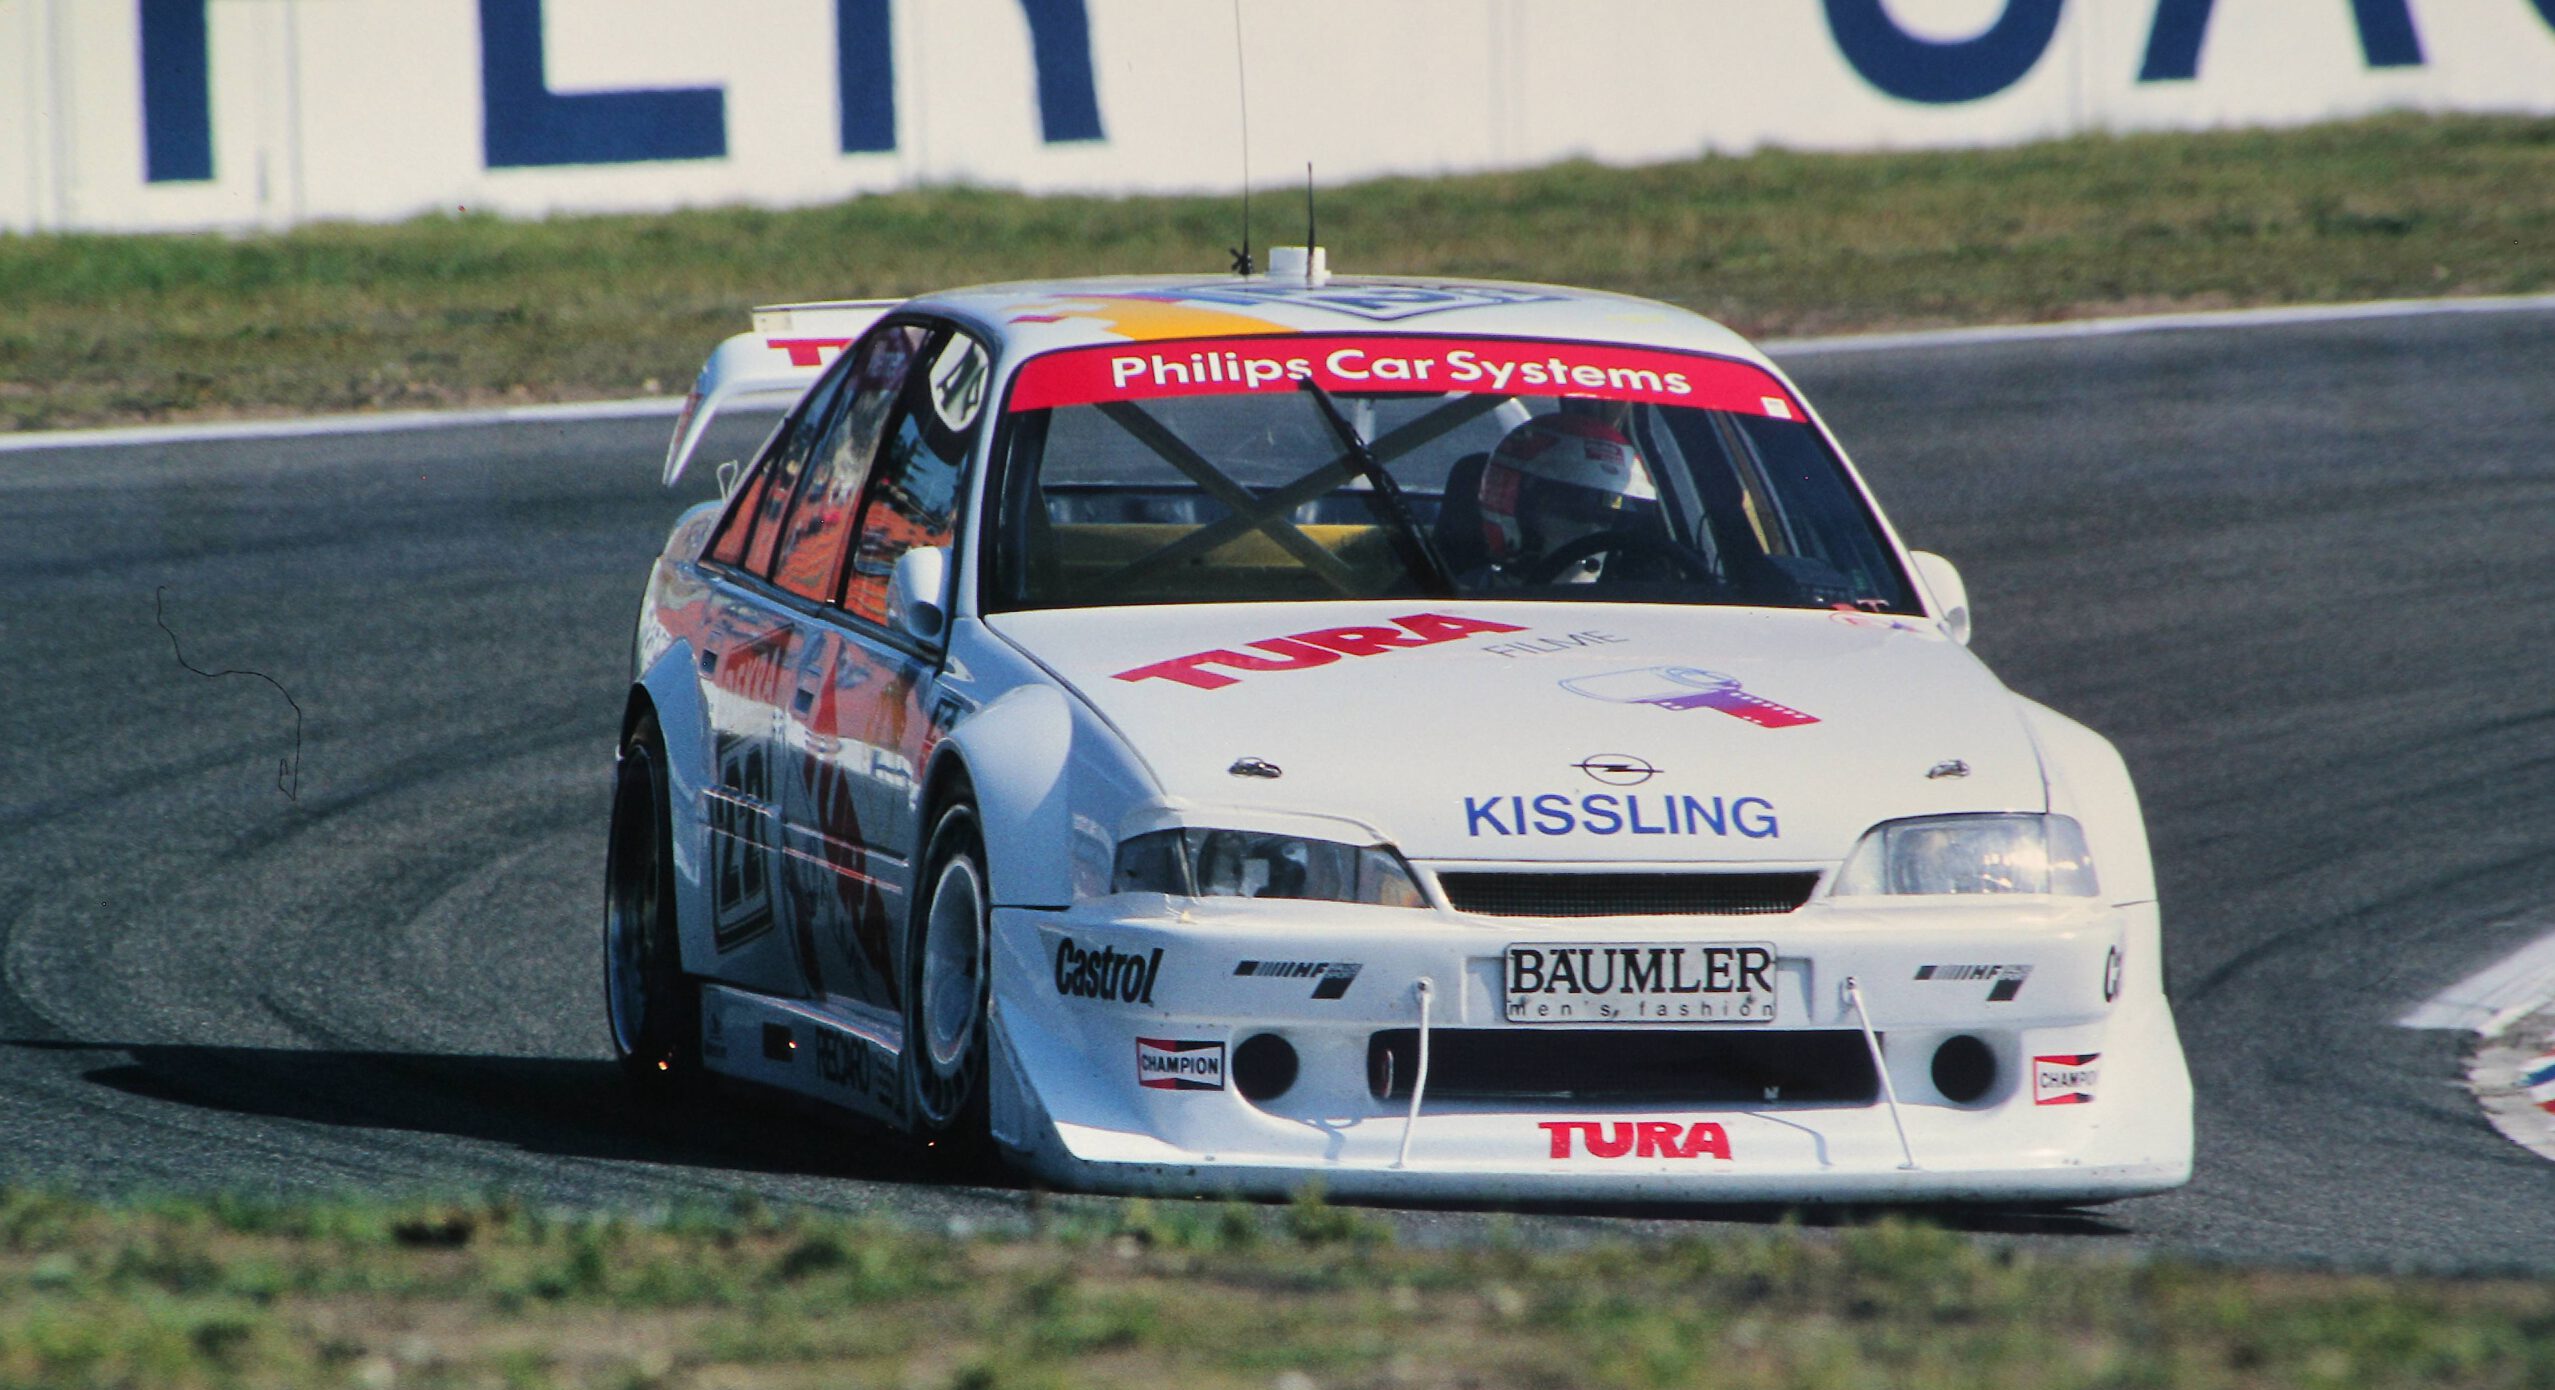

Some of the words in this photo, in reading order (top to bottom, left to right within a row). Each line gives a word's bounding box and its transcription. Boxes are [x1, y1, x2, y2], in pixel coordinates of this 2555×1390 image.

[1112, 351, 1312, 389] Philips
[1327, 349, 1435, 380] Car
[1446, 350, 1692, 395] Systems
[1112, 613, 1531, 690] TURA
[1482, 630, 1630, 658] FILME
[1464, 793, 1778, 837] KISSLING
[1055, 937, 1165, 1007] Castrol
[1509, 947, 1773, 995] BÄUMLER
[1639, 1000, 1774, 1017] fashion
[1142, 1054, 1219, 1075] CHAMPION
[1538, 1121, 1734, 1161] TURA
